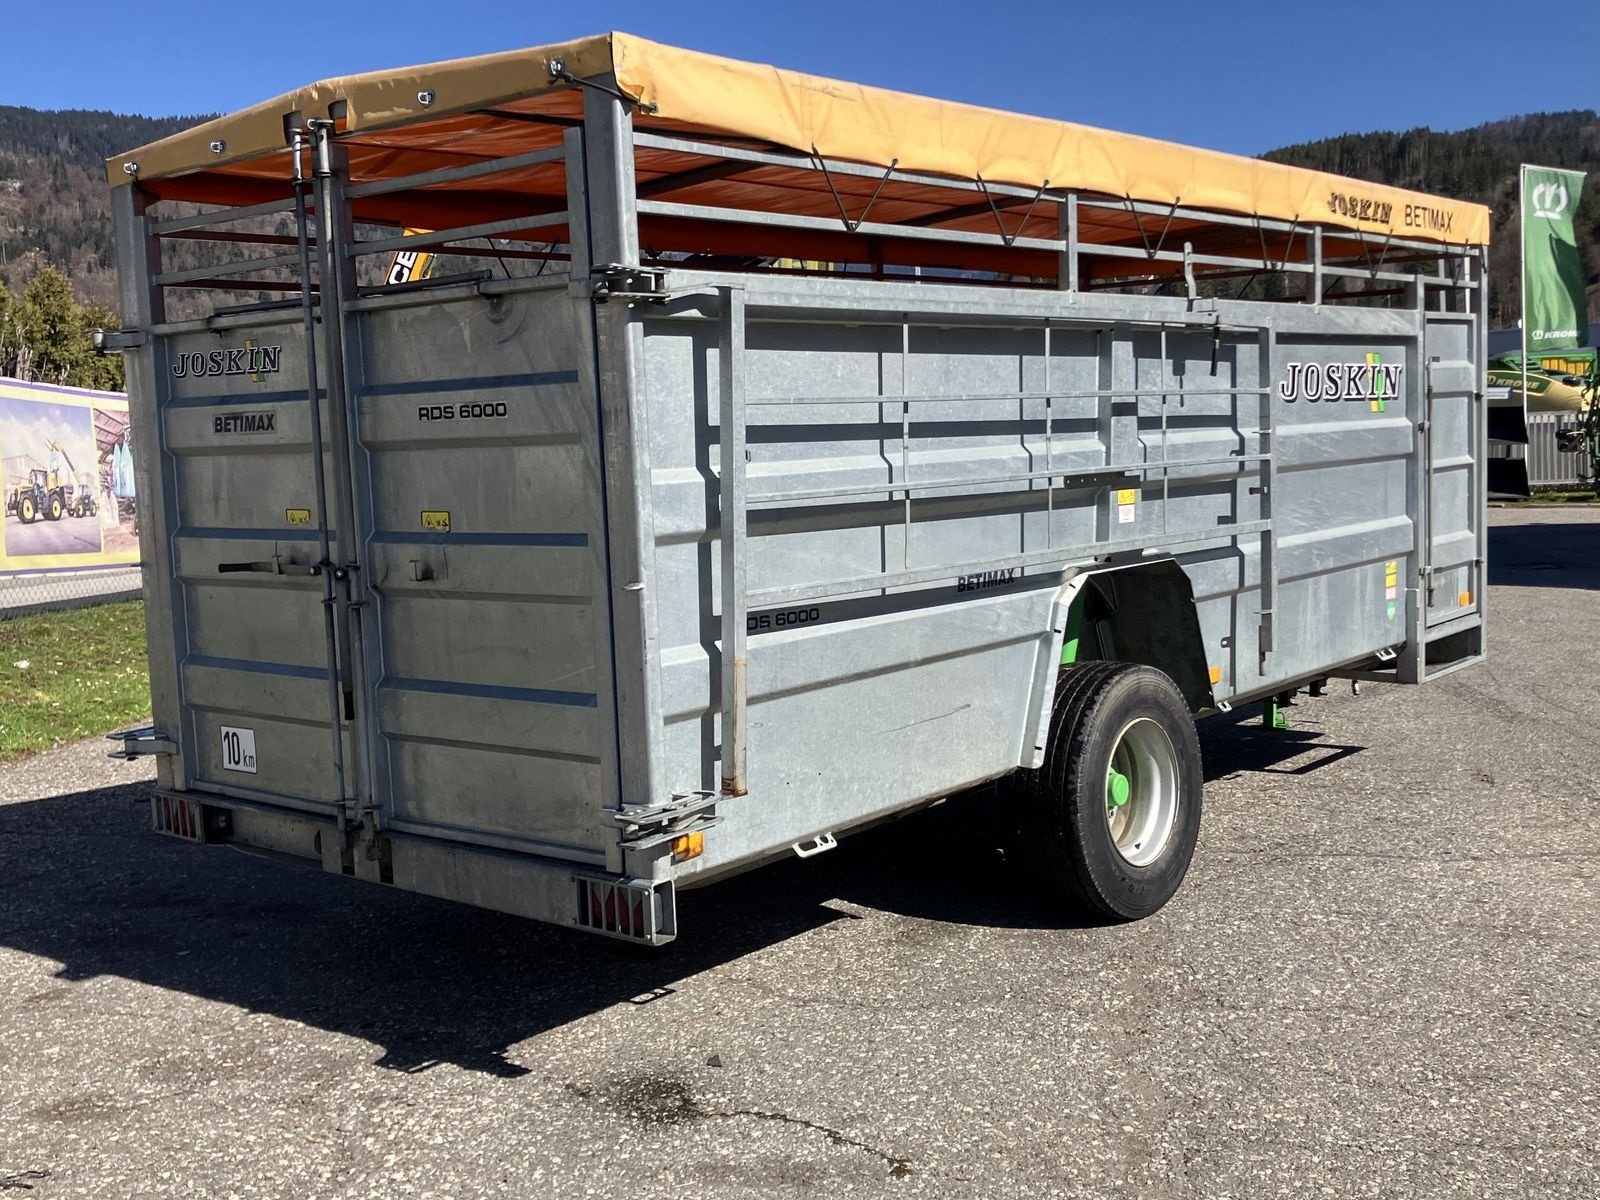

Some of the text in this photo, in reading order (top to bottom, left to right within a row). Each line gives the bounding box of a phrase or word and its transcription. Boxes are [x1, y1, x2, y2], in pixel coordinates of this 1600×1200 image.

[1327, 192, 1454, 234] JOSKIN BETIMAX
[173, 345, 281, 379] JOSKIN
[1279, 362, 1402, 403] JOSKIN
[214, 413, 275, 433] BETIMAX
[418, 402, 507, 421] RDS 6000
[957, 568, 1015, 592] BETIMAX
[746, 607, 820, 630] DS 6000
[223, 731, 255, 768] 10 km
